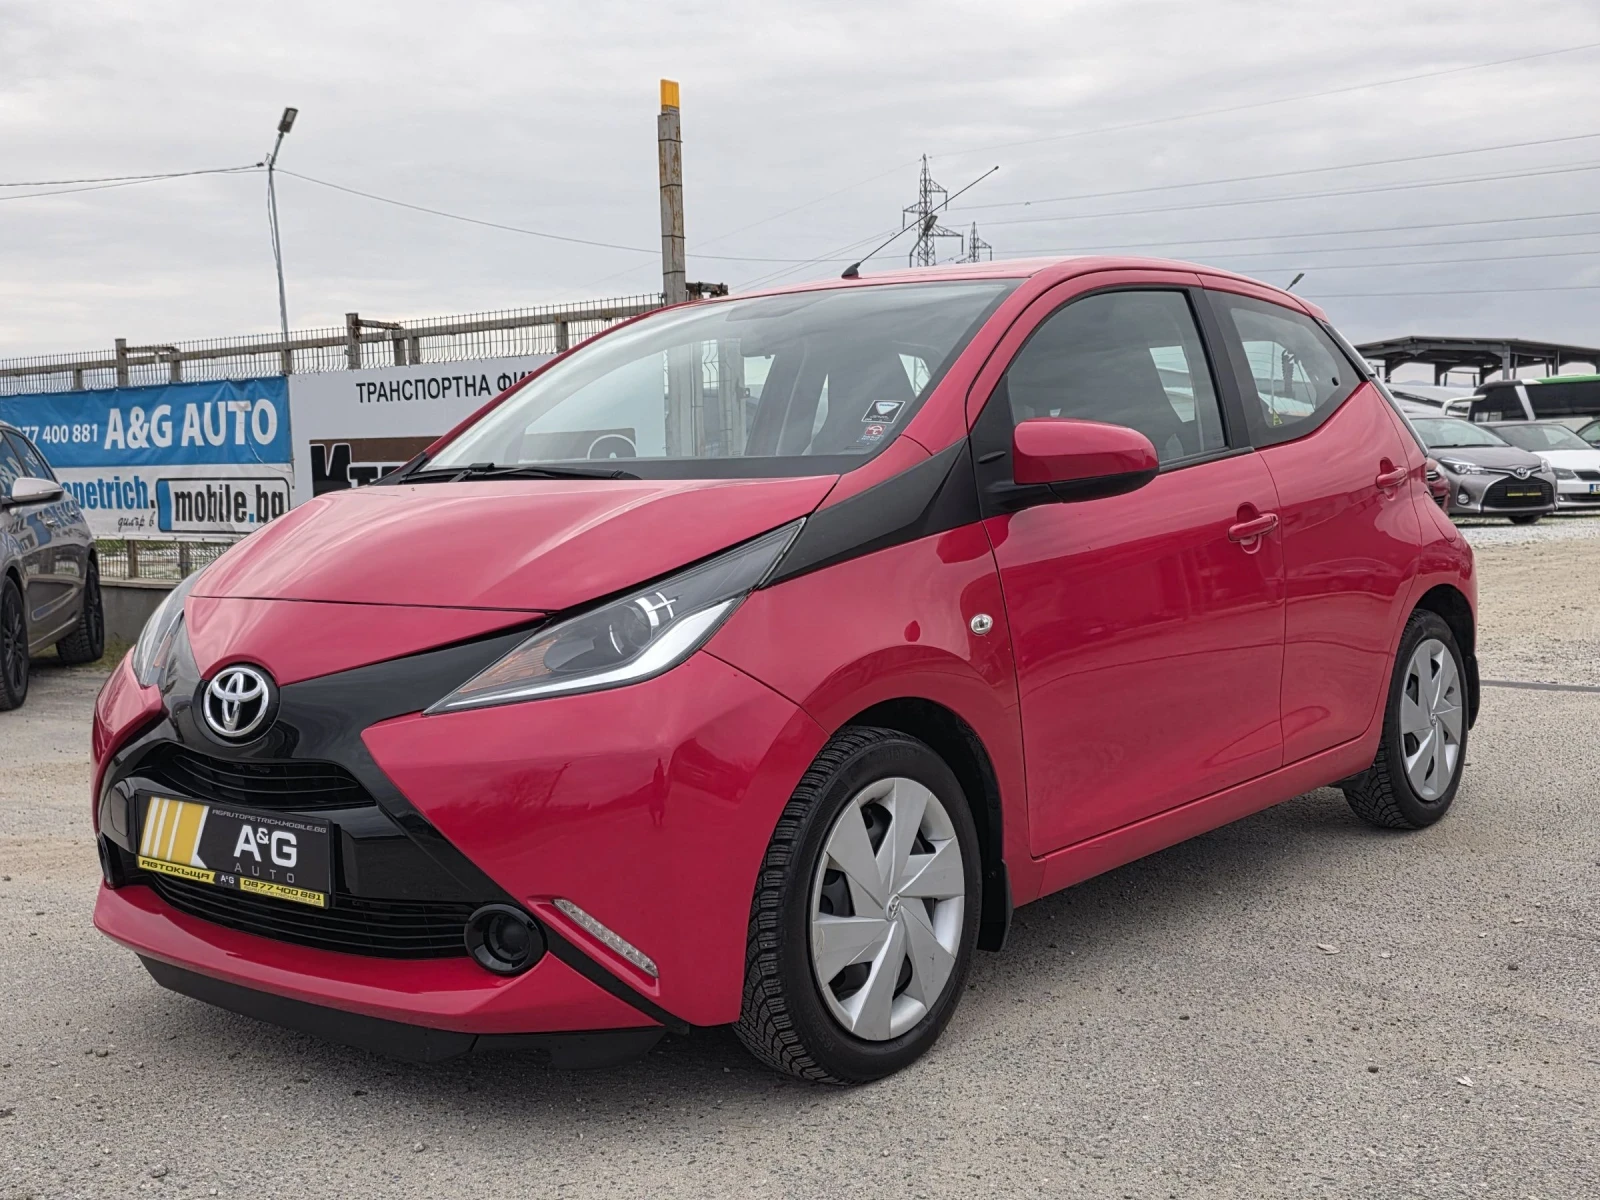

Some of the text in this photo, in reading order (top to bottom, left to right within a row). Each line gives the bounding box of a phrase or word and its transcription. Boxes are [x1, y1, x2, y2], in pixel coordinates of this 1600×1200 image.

[356, 374, 492, 403] ТРАНСПОРТНА
[42, 425, 69, 444] 400
[72, 423, 98, 443] 881
[104, 399, 278, 450] A&G AUTO
[233, 824, 297, 868] A&G
[141, 859, 210, 881] АВТОКЪЩА
[234, 862, 295, 884] AUTO
[243, 879, 273, 891] 0877
[276, 886, 298, 896] 400
[300, 891, 322, 901] 881
